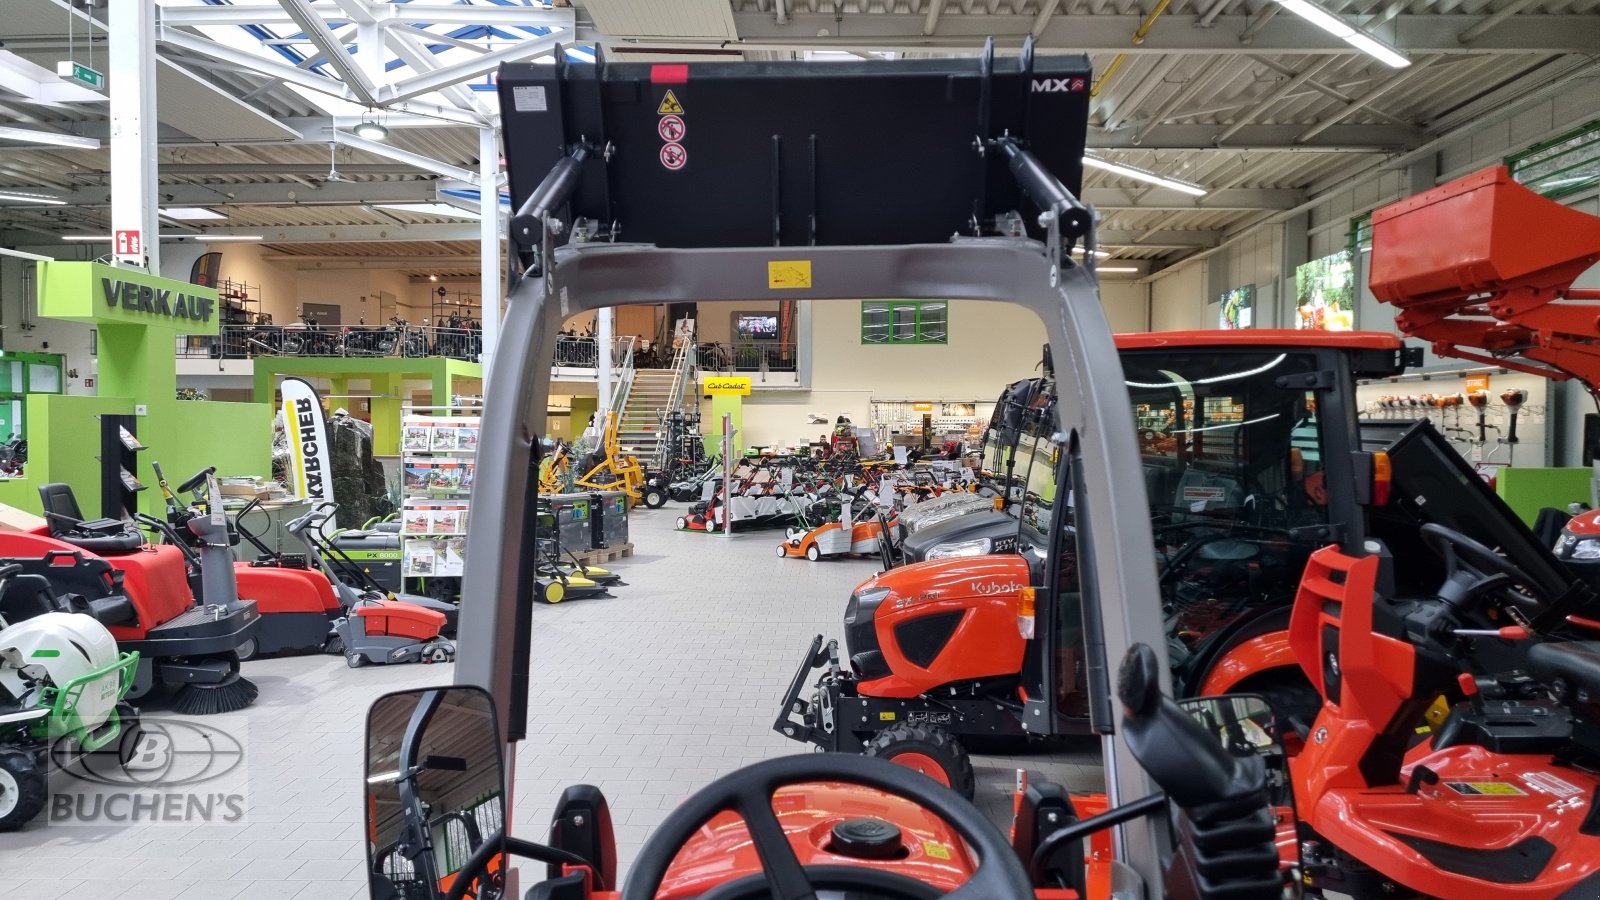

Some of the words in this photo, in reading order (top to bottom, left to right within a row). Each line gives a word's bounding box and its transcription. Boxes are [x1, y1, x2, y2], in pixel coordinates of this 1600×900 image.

[1031, 78, 1070, 92] MX
[101, 277, 215, 322] VERKAUF
[971, 580, 1024, 594] Kubota
